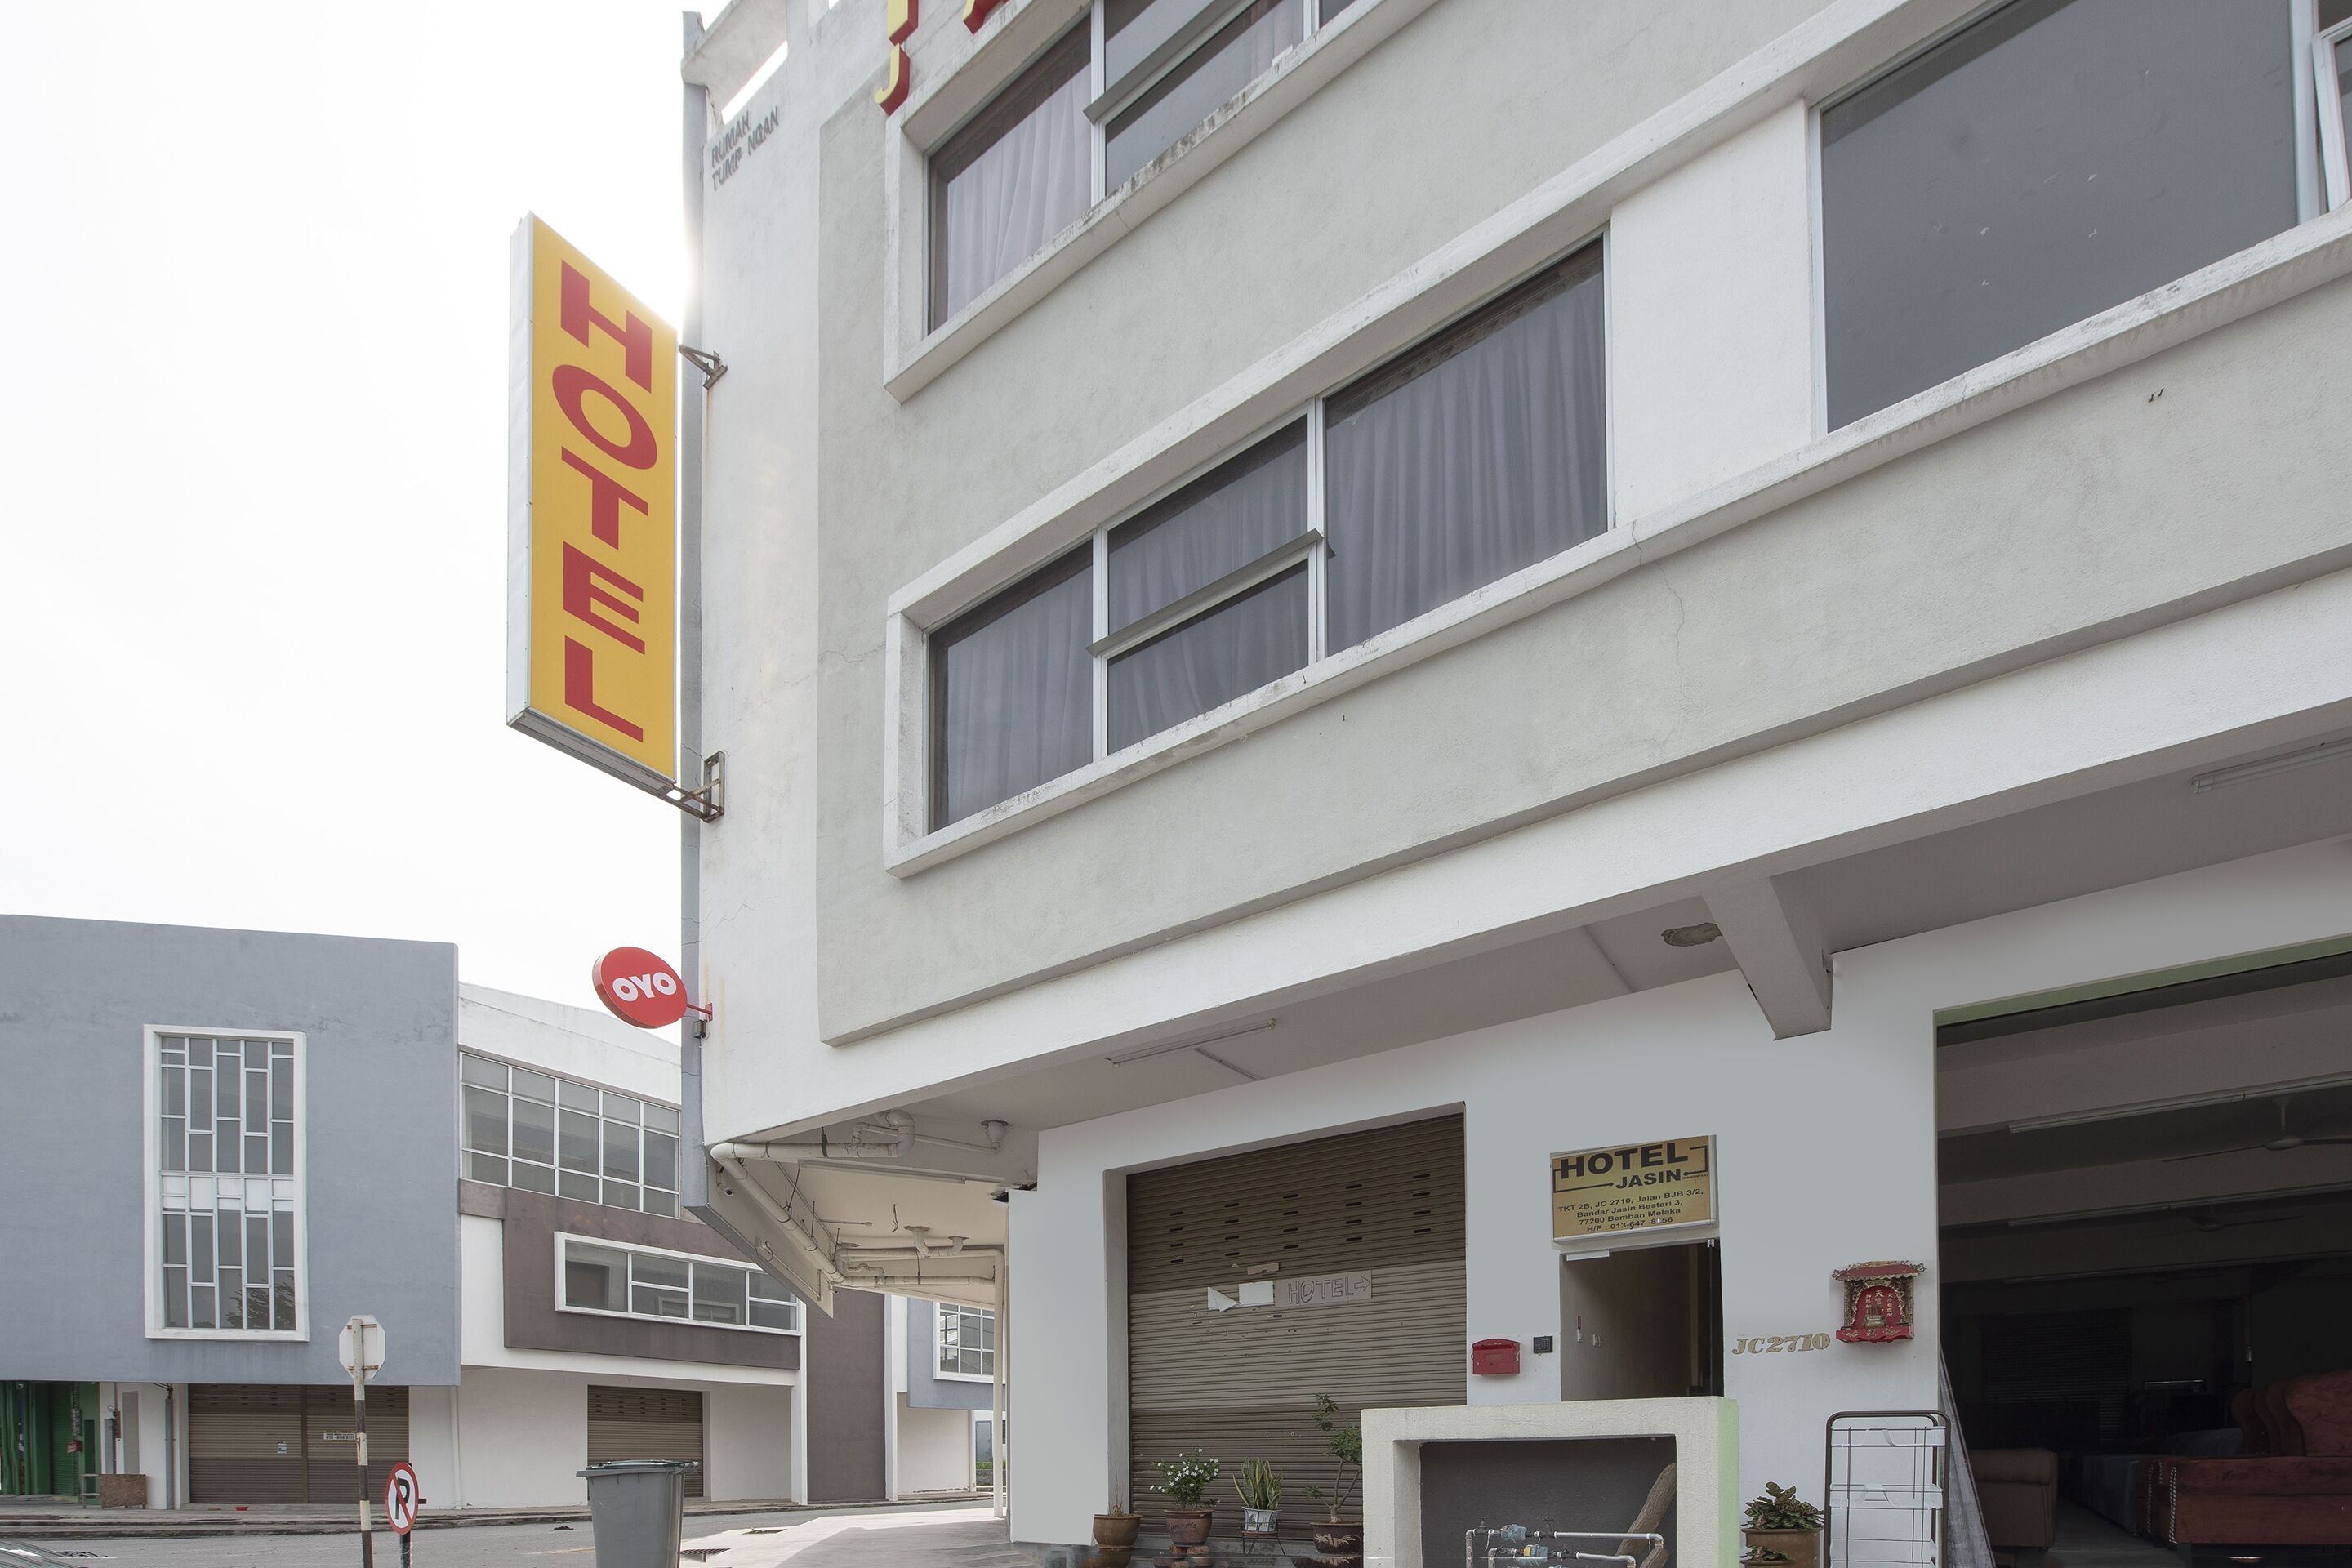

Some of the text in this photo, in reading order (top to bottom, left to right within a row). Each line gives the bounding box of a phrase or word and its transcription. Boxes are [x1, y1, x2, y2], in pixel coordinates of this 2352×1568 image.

[711, 110, 751, 170] RUMAH
[552, 259, 658, 743] HOTEL
[612, 972, 677, 1002] OYO
[1560, 1143, 1689, 1179] HOTEL
[1615, 1169, 1681, 1189] JASIN
[1558, 1205, 1576, 1213] TKT
[1636, 1195, 1661, 1203] Jalan
[1664, 1190, 1684, 1199] BJB
[1577, 1209, 1609, 1218] Bandar
[1611, 1205, 1636, 1214] Jasin
[1638, 1200, 1672, 1210] Bestari
[1579, 1208, 1681, 1226] 77200 Bemban Melaka
[1650, 1216, 1673, 1224] 856
[1287, 1276, 1354, 1304] HOTEL
[1731, 1332, 1831, 1355] JC2710
[395, 1477, 410, 1519] P
